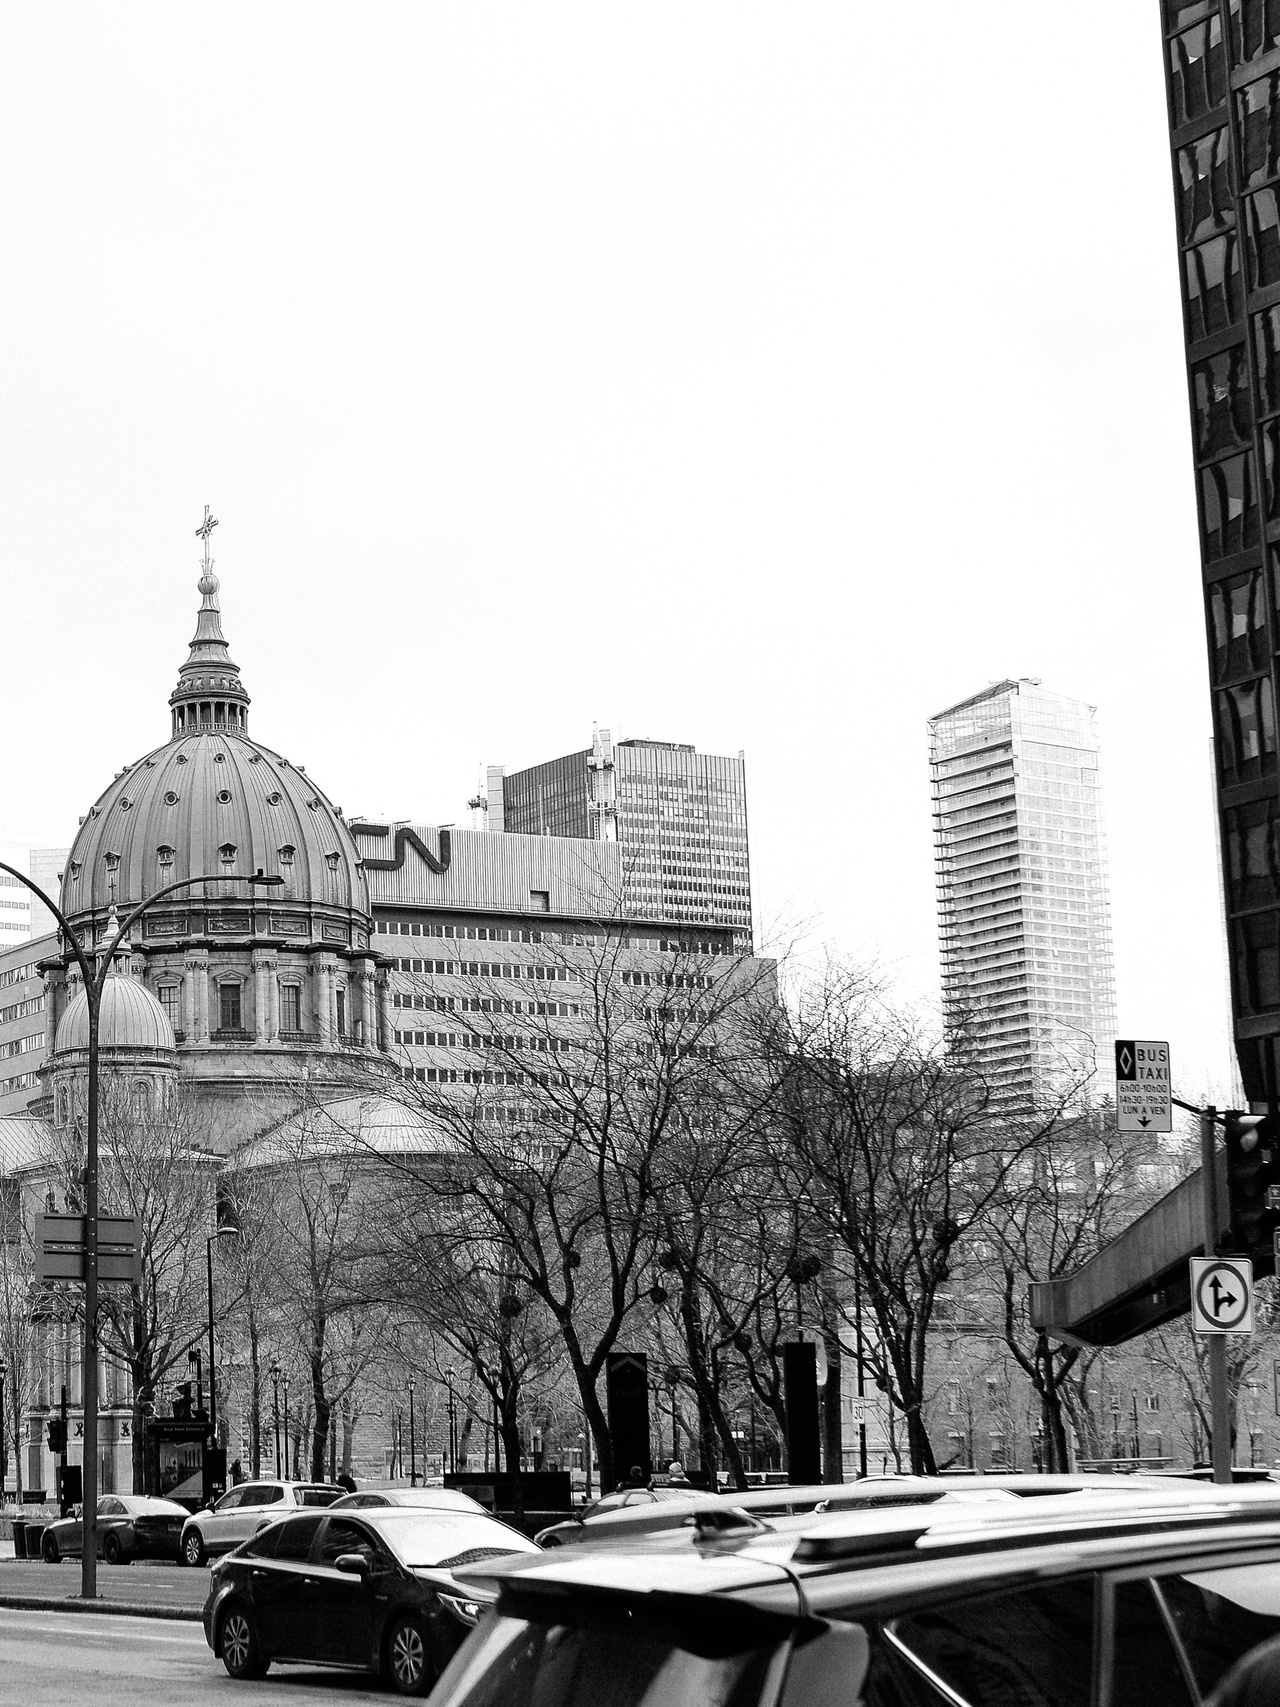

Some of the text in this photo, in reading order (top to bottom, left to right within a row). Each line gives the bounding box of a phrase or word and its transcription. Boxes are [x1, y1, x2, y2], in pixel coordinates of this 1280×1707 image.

[1137, 1048, 1167, 1062] BUS
[1138, 1066, 1168, 1081] TAXI
[1122, 1105, 1139, 1115] LUN
[1149, 1106, 1166, 1115] VEN
[853, 1405, 864, 1420] 30
